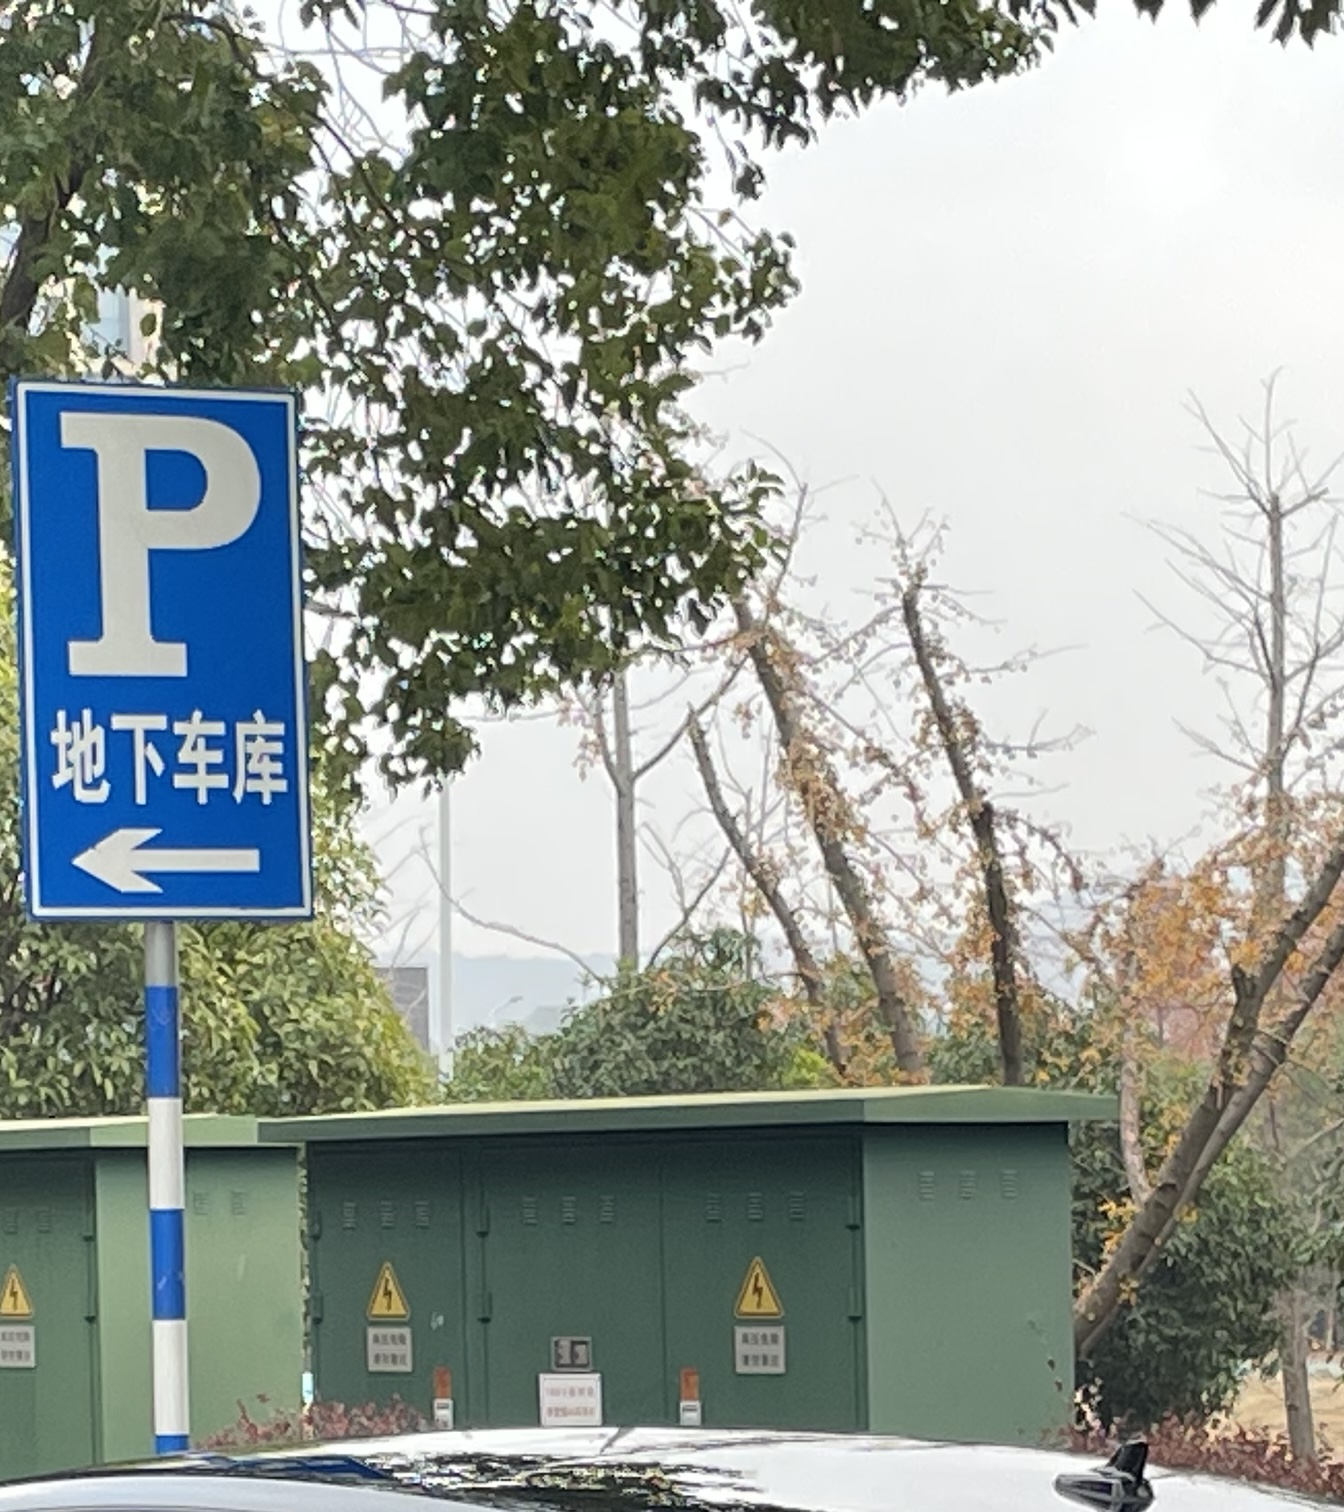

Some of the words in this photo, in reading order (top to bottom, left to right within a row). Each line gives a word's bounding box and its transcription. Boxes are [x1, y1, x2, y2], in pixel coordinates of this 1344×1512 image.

[59, 411, 261, 677] P
[50, 707, 288, 805] 地下车库
